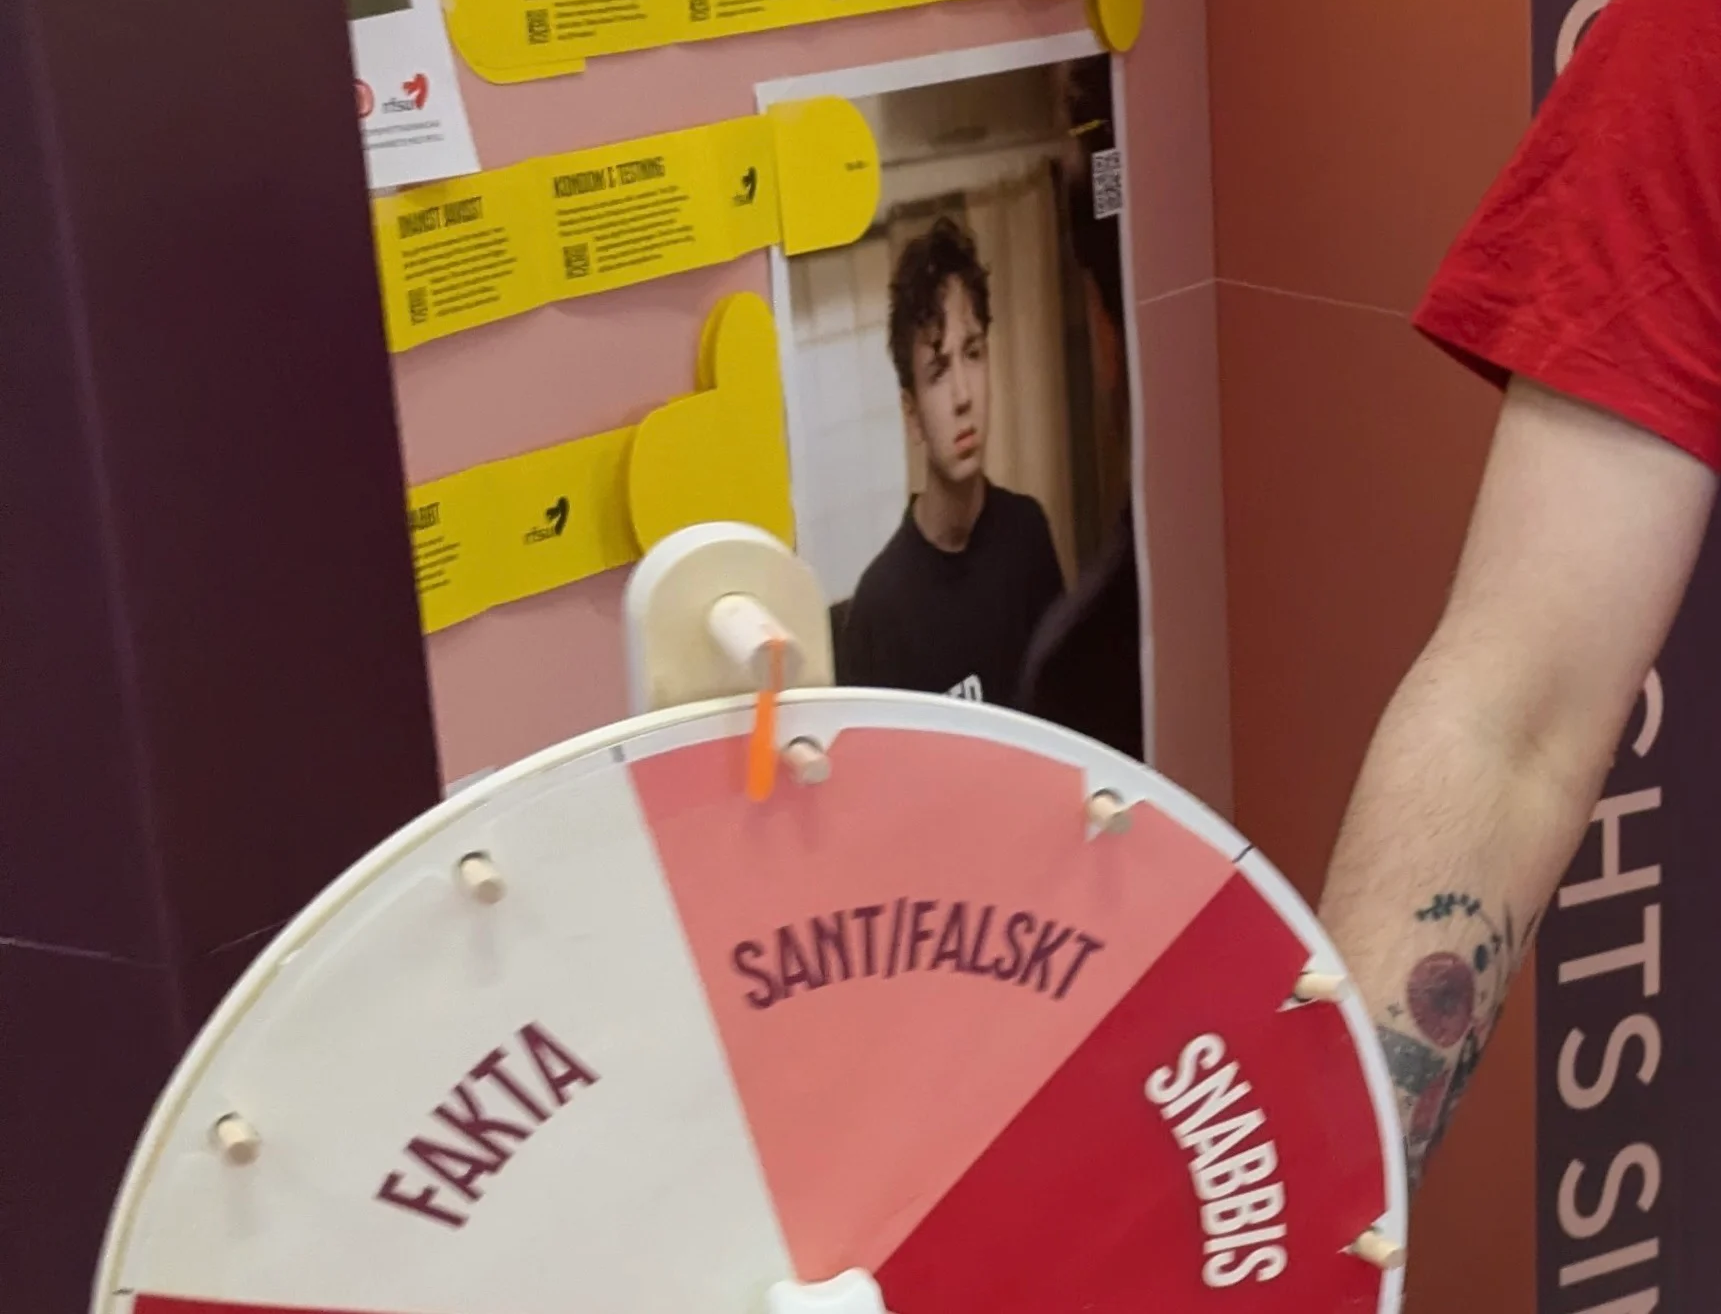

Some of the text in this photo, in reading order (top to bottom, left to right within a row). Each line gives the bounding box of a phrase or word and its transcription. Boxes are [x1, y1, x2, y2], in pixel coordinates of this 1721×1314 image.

[730, 895, 1106, 1011] SANT/FALSKT
[1557, 666, 1664, 1110] HTS
[374, 1020, 602, 1232] FAKTA
[1144, 1031, 1291, 1290] SNABBIS
